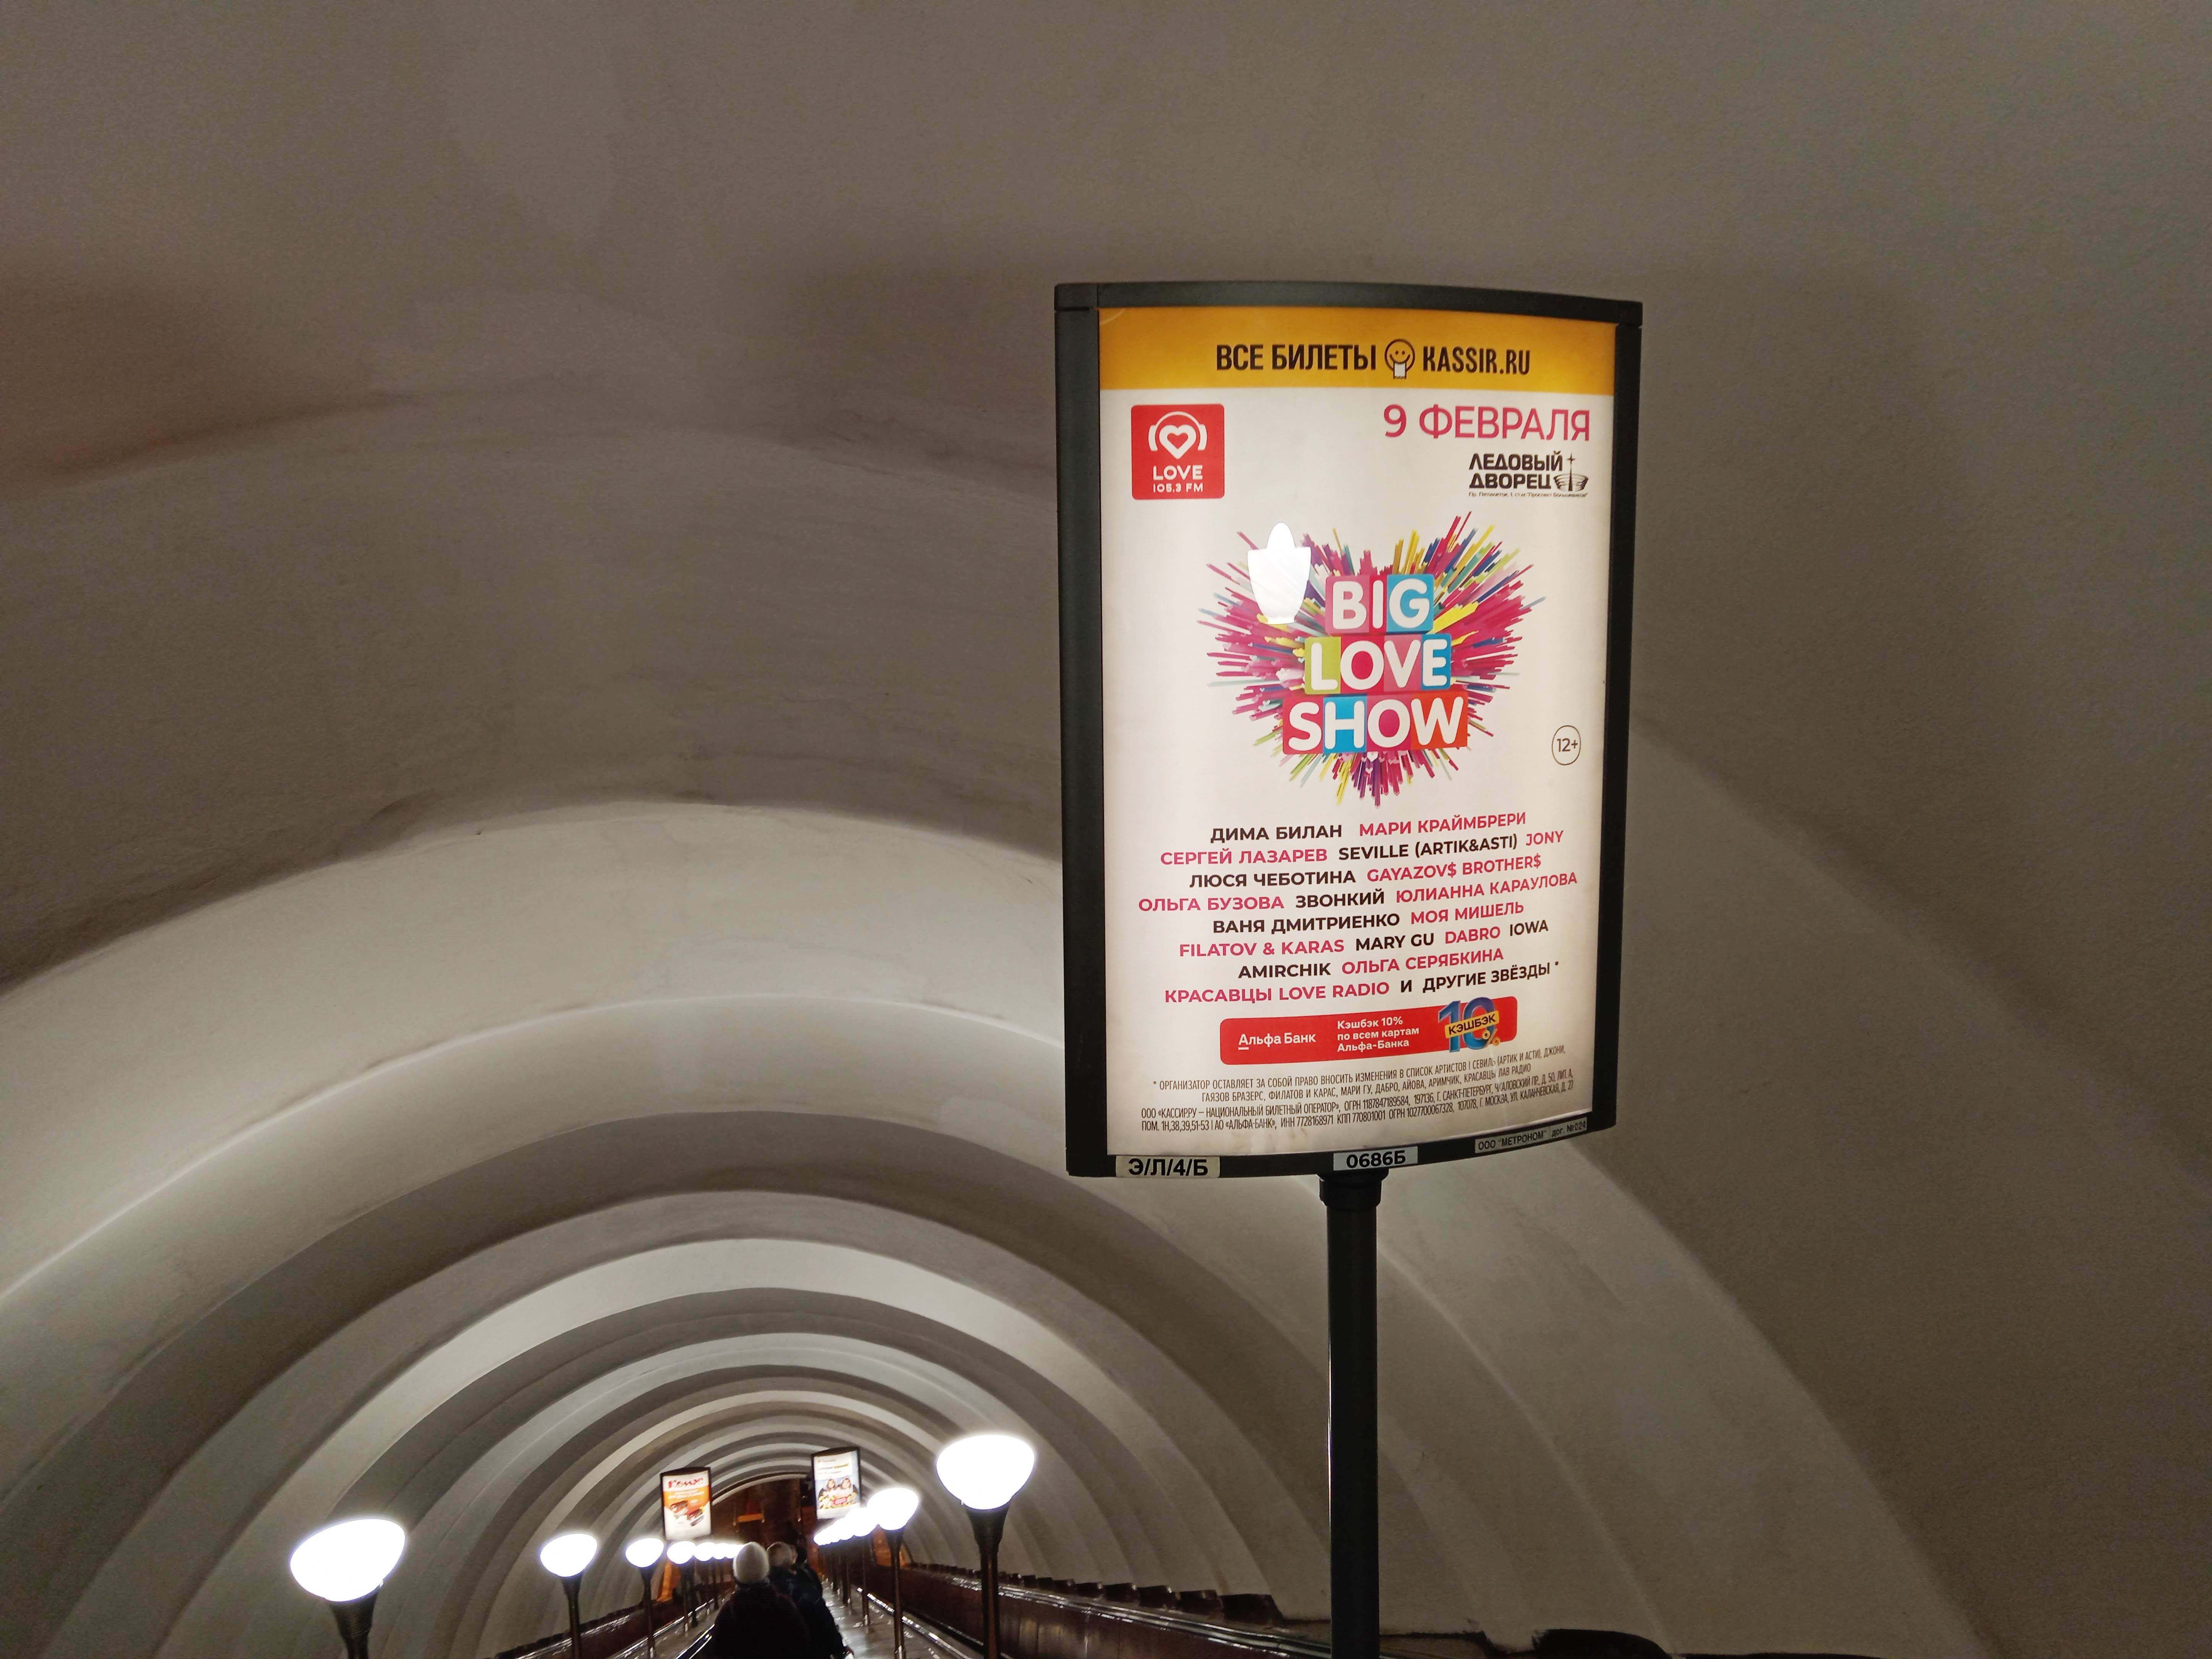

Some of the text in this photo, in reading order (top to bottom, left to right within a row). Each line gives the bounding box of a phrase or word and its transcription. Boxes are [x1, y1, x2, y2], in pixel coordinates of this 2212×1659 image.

[1216, 344, 1530, 375] ВСЕ БИЛЕТЫ KASSIR.RU
[1384, 403, 1590, 441] 9 ФЕВРАЛЯ
[1153, 465, 1203, 480] LOVE
[1469, 450, 1563, 471] ЛЕДОВЫЙ
[1153, 483, 1203, 493] 105.3 FM
[1469, 473, 1551, 489] ДВОРЕЦ
[1332, 579, 1431, 630] BIG
[1310, 638, 1448, 692] LOVE
[1288, 697, 1464, 751] SHOW
[1557, 738, 1578, 752] 12+
[1210, 812, 1526, 843] ДИМА БИЛАН МАРИ КРАЙМБРЕРИ
[1160, 831, 1564, 865] СЕРГЕЙ ЛАЗАРЕВ SEVILLE (ARTIK&ASTI) JONY
[1190, 853, 1541, 888] ЛЮСЯ ЧЕБОТИНА GAYAZOV$ BROTHER$
[1138, 872, 1577, 912] ОЛЬГА БУЗОВА ЗВОНКИЙ ЮЛИАННА КАРАУЛОВА
[1213, 902, 1524, 935] ВАНЯ ДМИТРИЕНКО МОЯ МИШЕЛЬ
[1180, 920, 1549, 957] FILATOV & KARAS MARY GU DABRO IOWA
[1238, 948, 1504, 978] AMIRCHIK ОЛЬГА СЕРЯБКИНА
[1165, 962, 1550, 1004] КРАСАВЦЫ LOVE RADIO И ДРУГИЕ ЗВЁЗДЫ
[1337, 1016, 1403, 1029] Кэшбэк 10%
[1353, 1031, 1379, 1040] всем
[1382, 1028, 1419, 1038] картам
[1449, 1014, 1496, 1035] КЭШБЭК
[1238, 1032, 1316, 1048] Альфа Банк
[1337, 1040, 1409, 1052] Альфа-Банка
[1159, 1080, 1210, 1090] ОРГАНИЗАТОР
[1213, 1079, 1253, 1089] ОСТАВЛЯЕТ
[1256, 1079, 1265, 1088] ЗА
[1268, 1076, 1292, 1088] СОБОЙ
[1295, 1077, 1318, 1086] ПРАВО
[1321, 1074, 1353, 1084] ВНОСИТЬ
[1355, 1070, 1397, 1082] ИЗМЕНЕНИЯ
[1400, 1070, 1404, 1078] В
[1406, 1066, 1433, 1077] СПИСОК
[1435, 1062, 1467, 1074] АРТИСТОВ
[1497, 1053, 1517, 1066] (АРТИК
[1520, 1051, 1523, 1061] И
[1202, 1092, 1229, 1102] ГАЯЗОВ
[1233, 1091, 1266, 1101] БРАЗЕРС,
[1269, 1090, 1303, 1100] ФИЛАТОВ
[1307, 1089, 1311, 1098] И
[1314, 1087, 1338, 1098] КАРАС,
[1341, 1085, 1360, 1096] МАРИ
[1363, 1084, 1373, 1095] ГУ,
[1375, 1083, 1400, 1094] ДАБРО,
[1402, 1079, 1426, 1091] АЙОВА,
[1429, 1075, 1462, 1087] АРИМЧИК,
[1498, 1067, 1509, 1077] ЛАВ
[1512, 1063, 1531, 1075] РАДИО
[1142, 1108, 1156, 1118] ООО
[1206, 1104, 1263, 1118] НАЦИОНАЛЬНЫЙ
[1266, 1103, 1301, 1116] БИЛЕТНЫЙ
[1344, 1099, 1361, 1111] ОГРН
[1443, 1084, 1493, 1101] САНКТ-ПЕТЕРБУРГ,
[1142, 1121, 1159, 1131] ПОМ.
[1215, 1120, 1224, 1130] АО
[1226, 1119, 1276, 1130] «АЛЬФА-БАНК»,
[1281, 1117, 1295, 1127] ИНН
[1297, 1115, 1333, 1127] 7728168971
[1337, 1114, 1350, 1124] КПП
[1352, 1110, 1386, 1122] 770801001
[1389, 1109, 1405, 1119] ОГРН
[1346, 1150, 1406, 1168] 0686Б
[1478, 1140, 1496, 1150] ООО
[1128, 1158, 1208, 1176] Э/Л/4/Б
